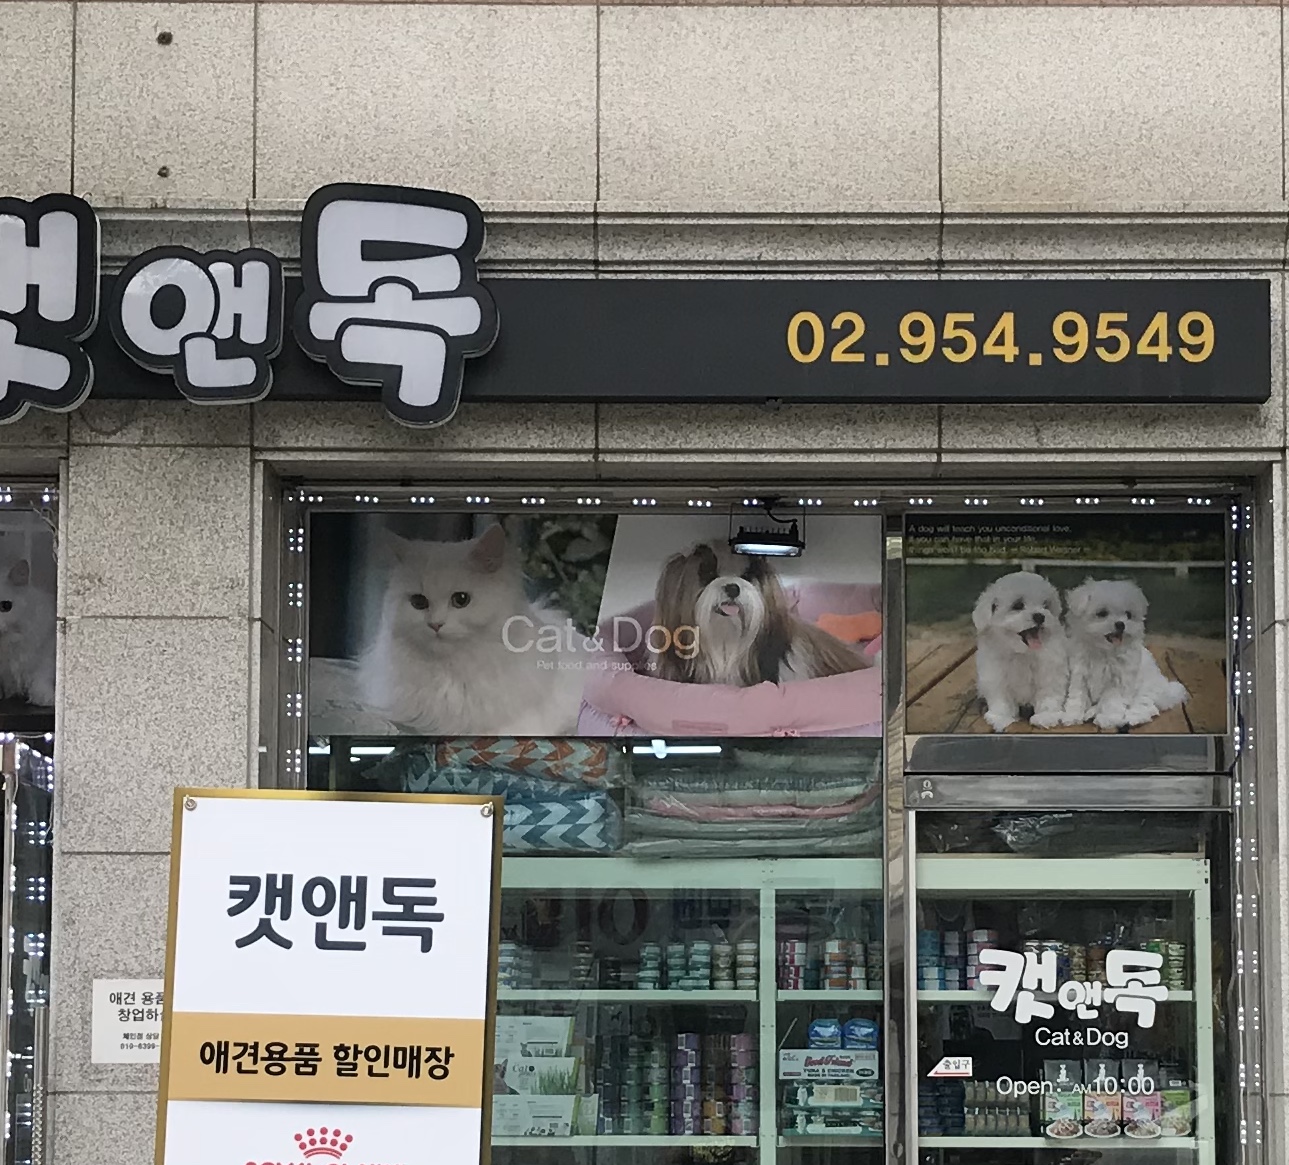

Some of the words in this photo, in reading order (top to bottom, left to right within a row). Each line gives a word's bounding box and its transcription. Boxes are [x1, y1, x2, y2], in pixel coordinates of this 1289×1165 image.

[787, 311, 1215, 366] 02.954.9549
[227, 874, 444, 953] 캣앤독
[109, 992, 136, 1005] 애견
[141, 992, 164, 1005] 용품
[979, 948, 1168, 1028] 캣앤독
[118, 1008, 163, 1021] 창업하
[1035, 1027, 1129, 1048] Cat&Dog
[199, 1040, 323, 1076] 애견용품
[333, 1043, 455, 1080] 할인매장
